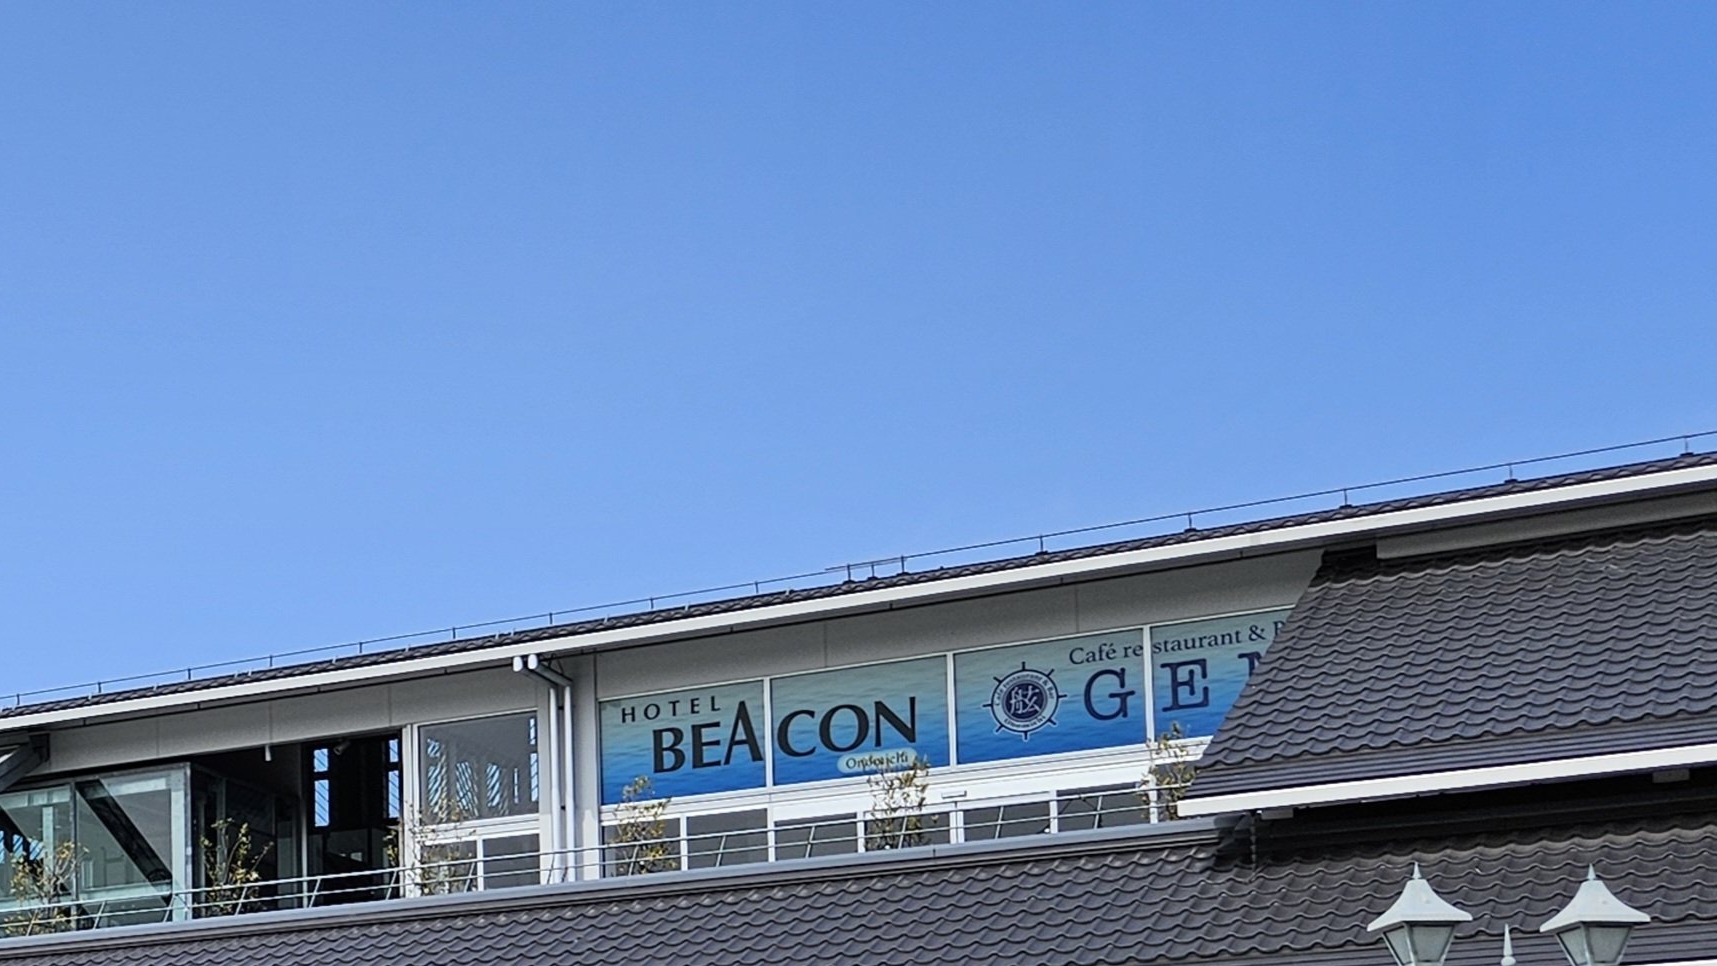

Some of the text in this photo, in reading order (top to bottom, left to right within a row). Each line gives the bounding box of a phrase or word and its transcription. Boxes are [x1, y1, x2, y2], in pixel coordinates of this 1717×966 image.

[1069, 643, 1116, 665] Café
[1123, 630, 1241, 659] restaurant
[1248, 624, 1266, 641] &
[621, 695, 721, 723] HOTEL
[652, 696, 916, 774] BEACON
